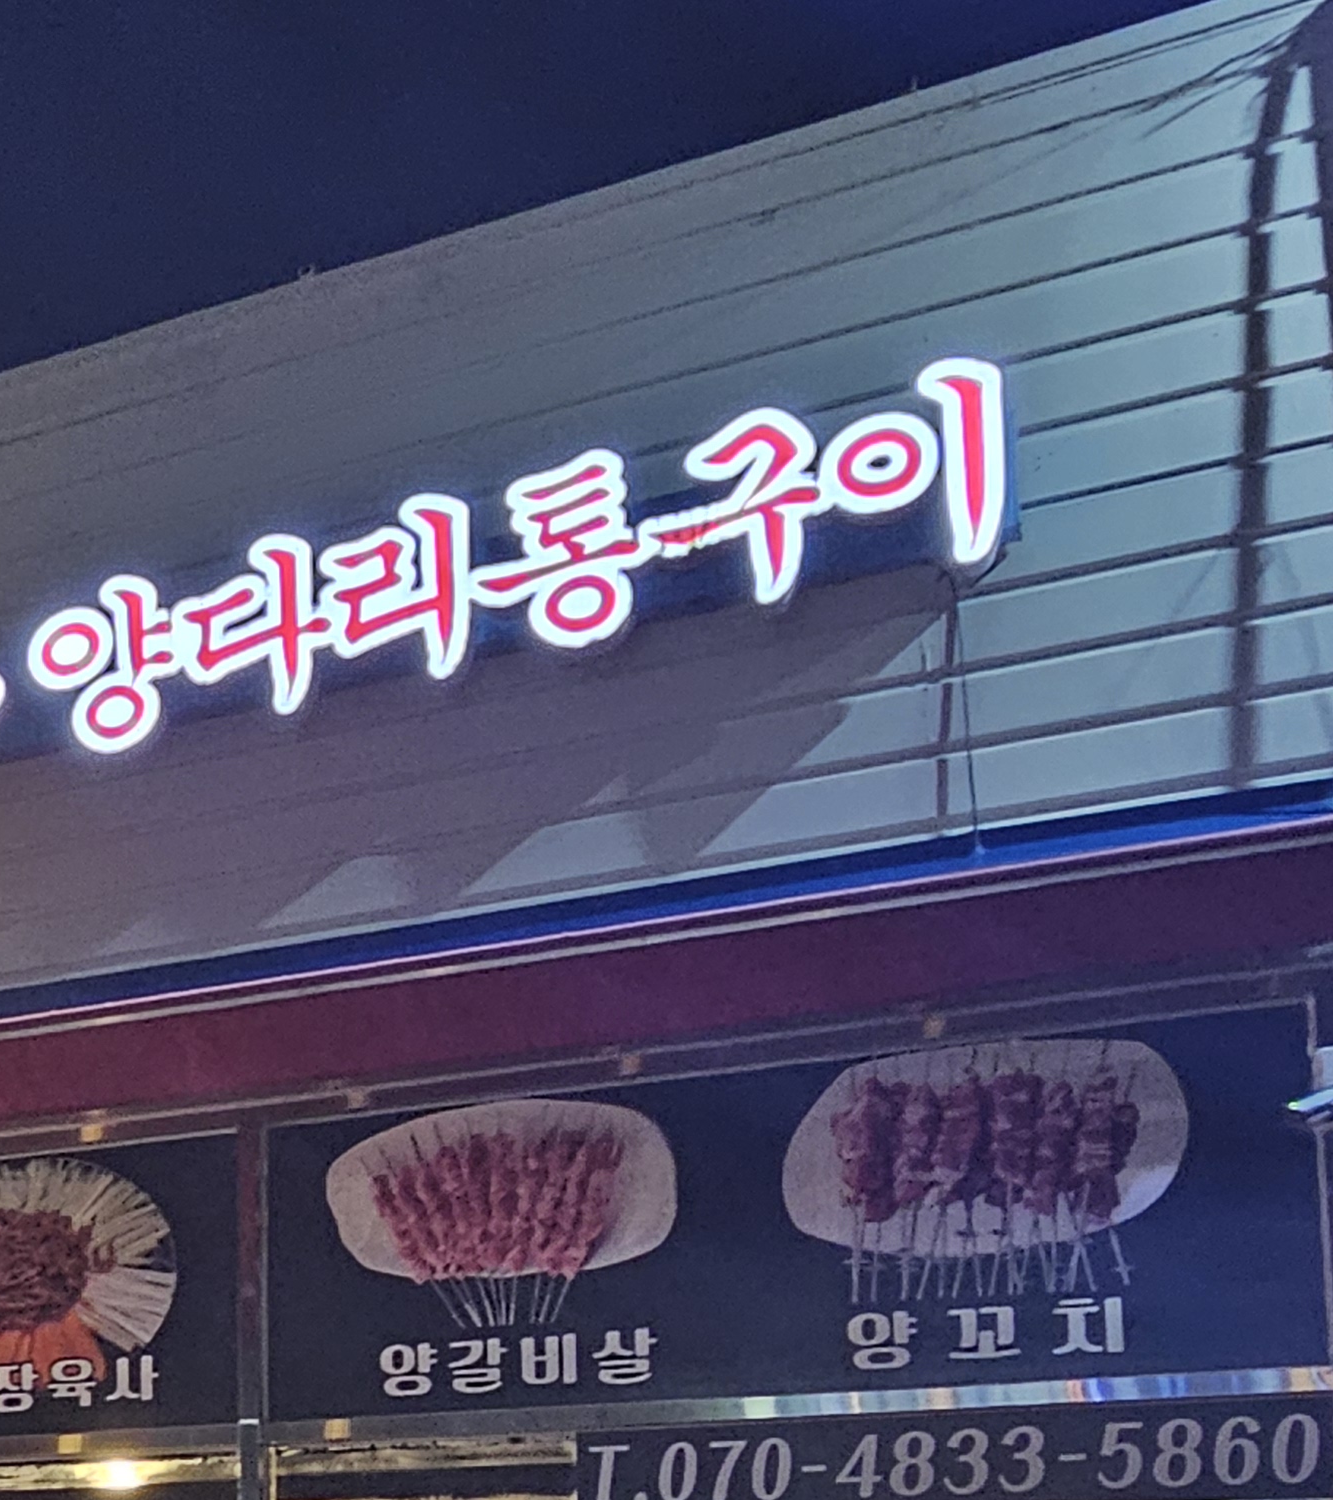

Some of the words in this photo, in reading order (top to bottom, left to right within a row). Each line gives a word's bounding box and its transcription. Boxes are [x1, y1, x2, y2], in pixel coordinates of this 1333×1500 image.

[27, 358, 1004, 754] 양다리통구이
[377, 1326, 660, 1398] 양갈비살
[846, 1296, 1125, 1370] 양꼬치
